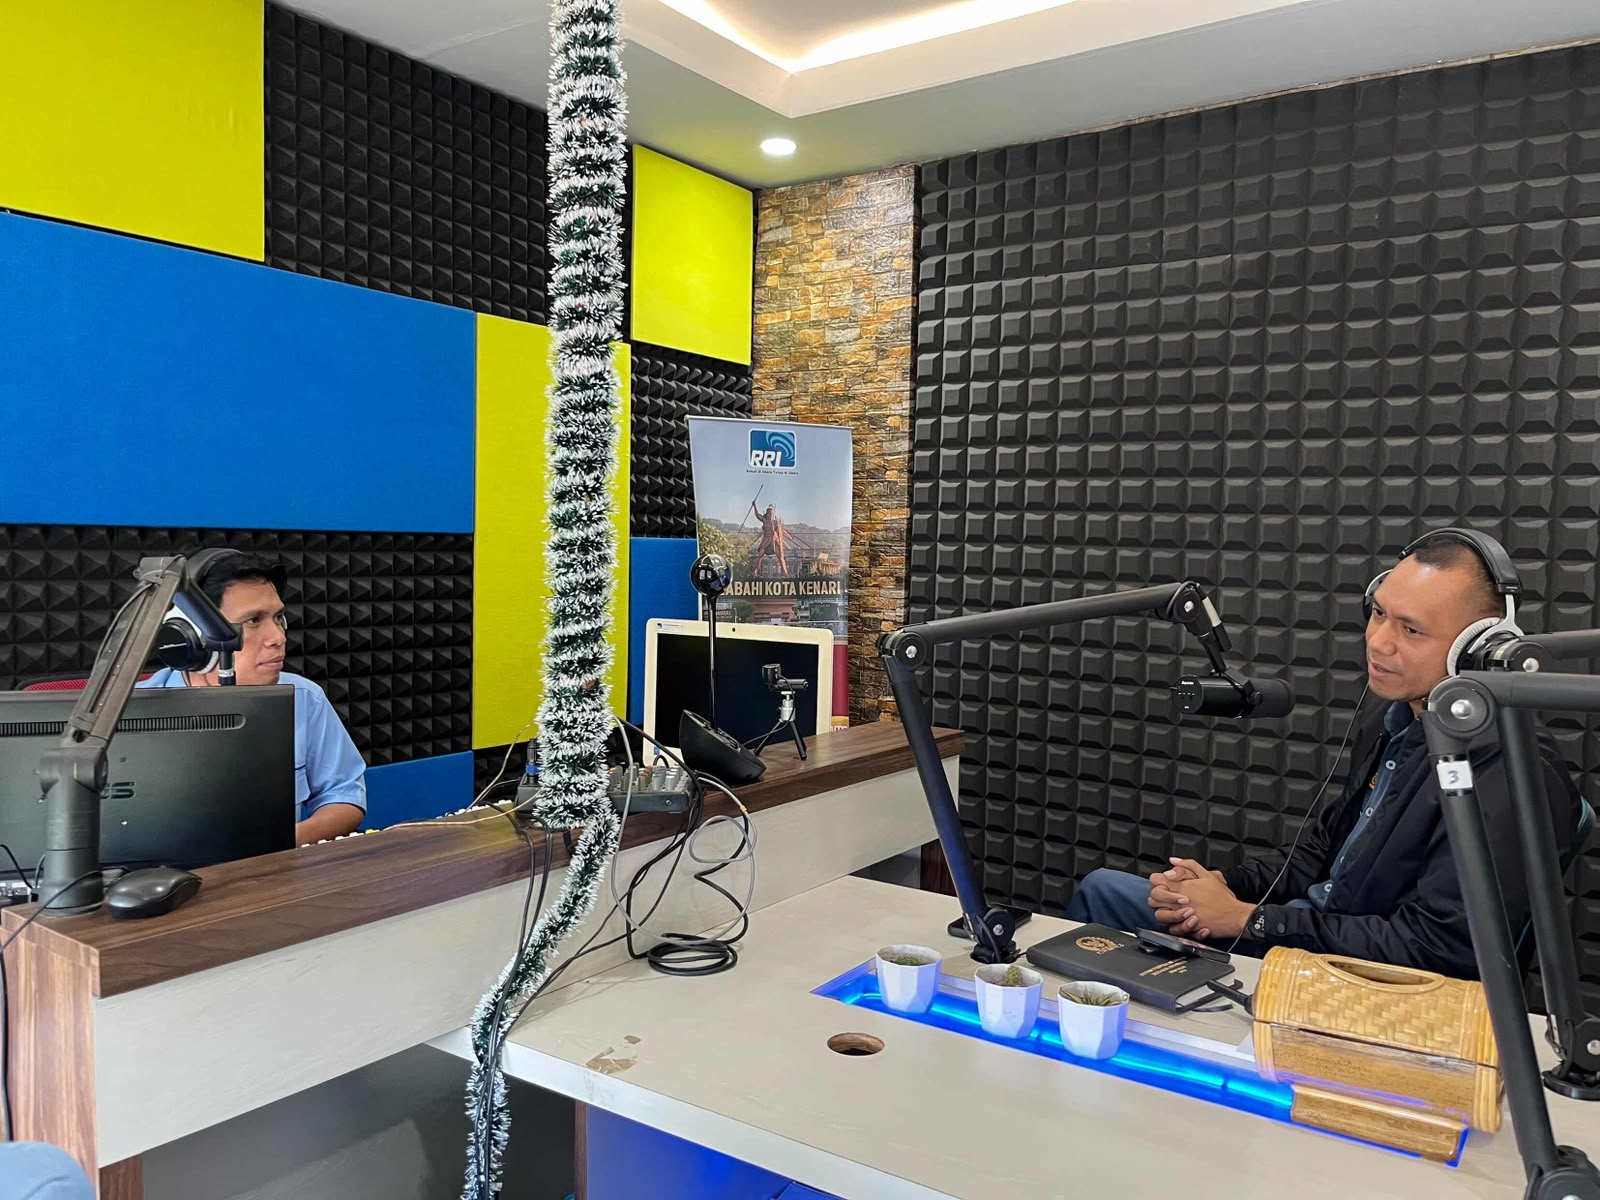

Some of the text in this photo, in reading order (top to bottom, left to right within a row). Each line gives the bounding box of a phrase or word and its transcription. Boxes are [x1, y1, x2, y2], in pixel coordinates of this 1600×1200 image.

[750, 449, 782, 468] RRI
[720, 580, 841, 596] ABAHI KOTA KENARI
[1447, 769, 1460, 785] 3
